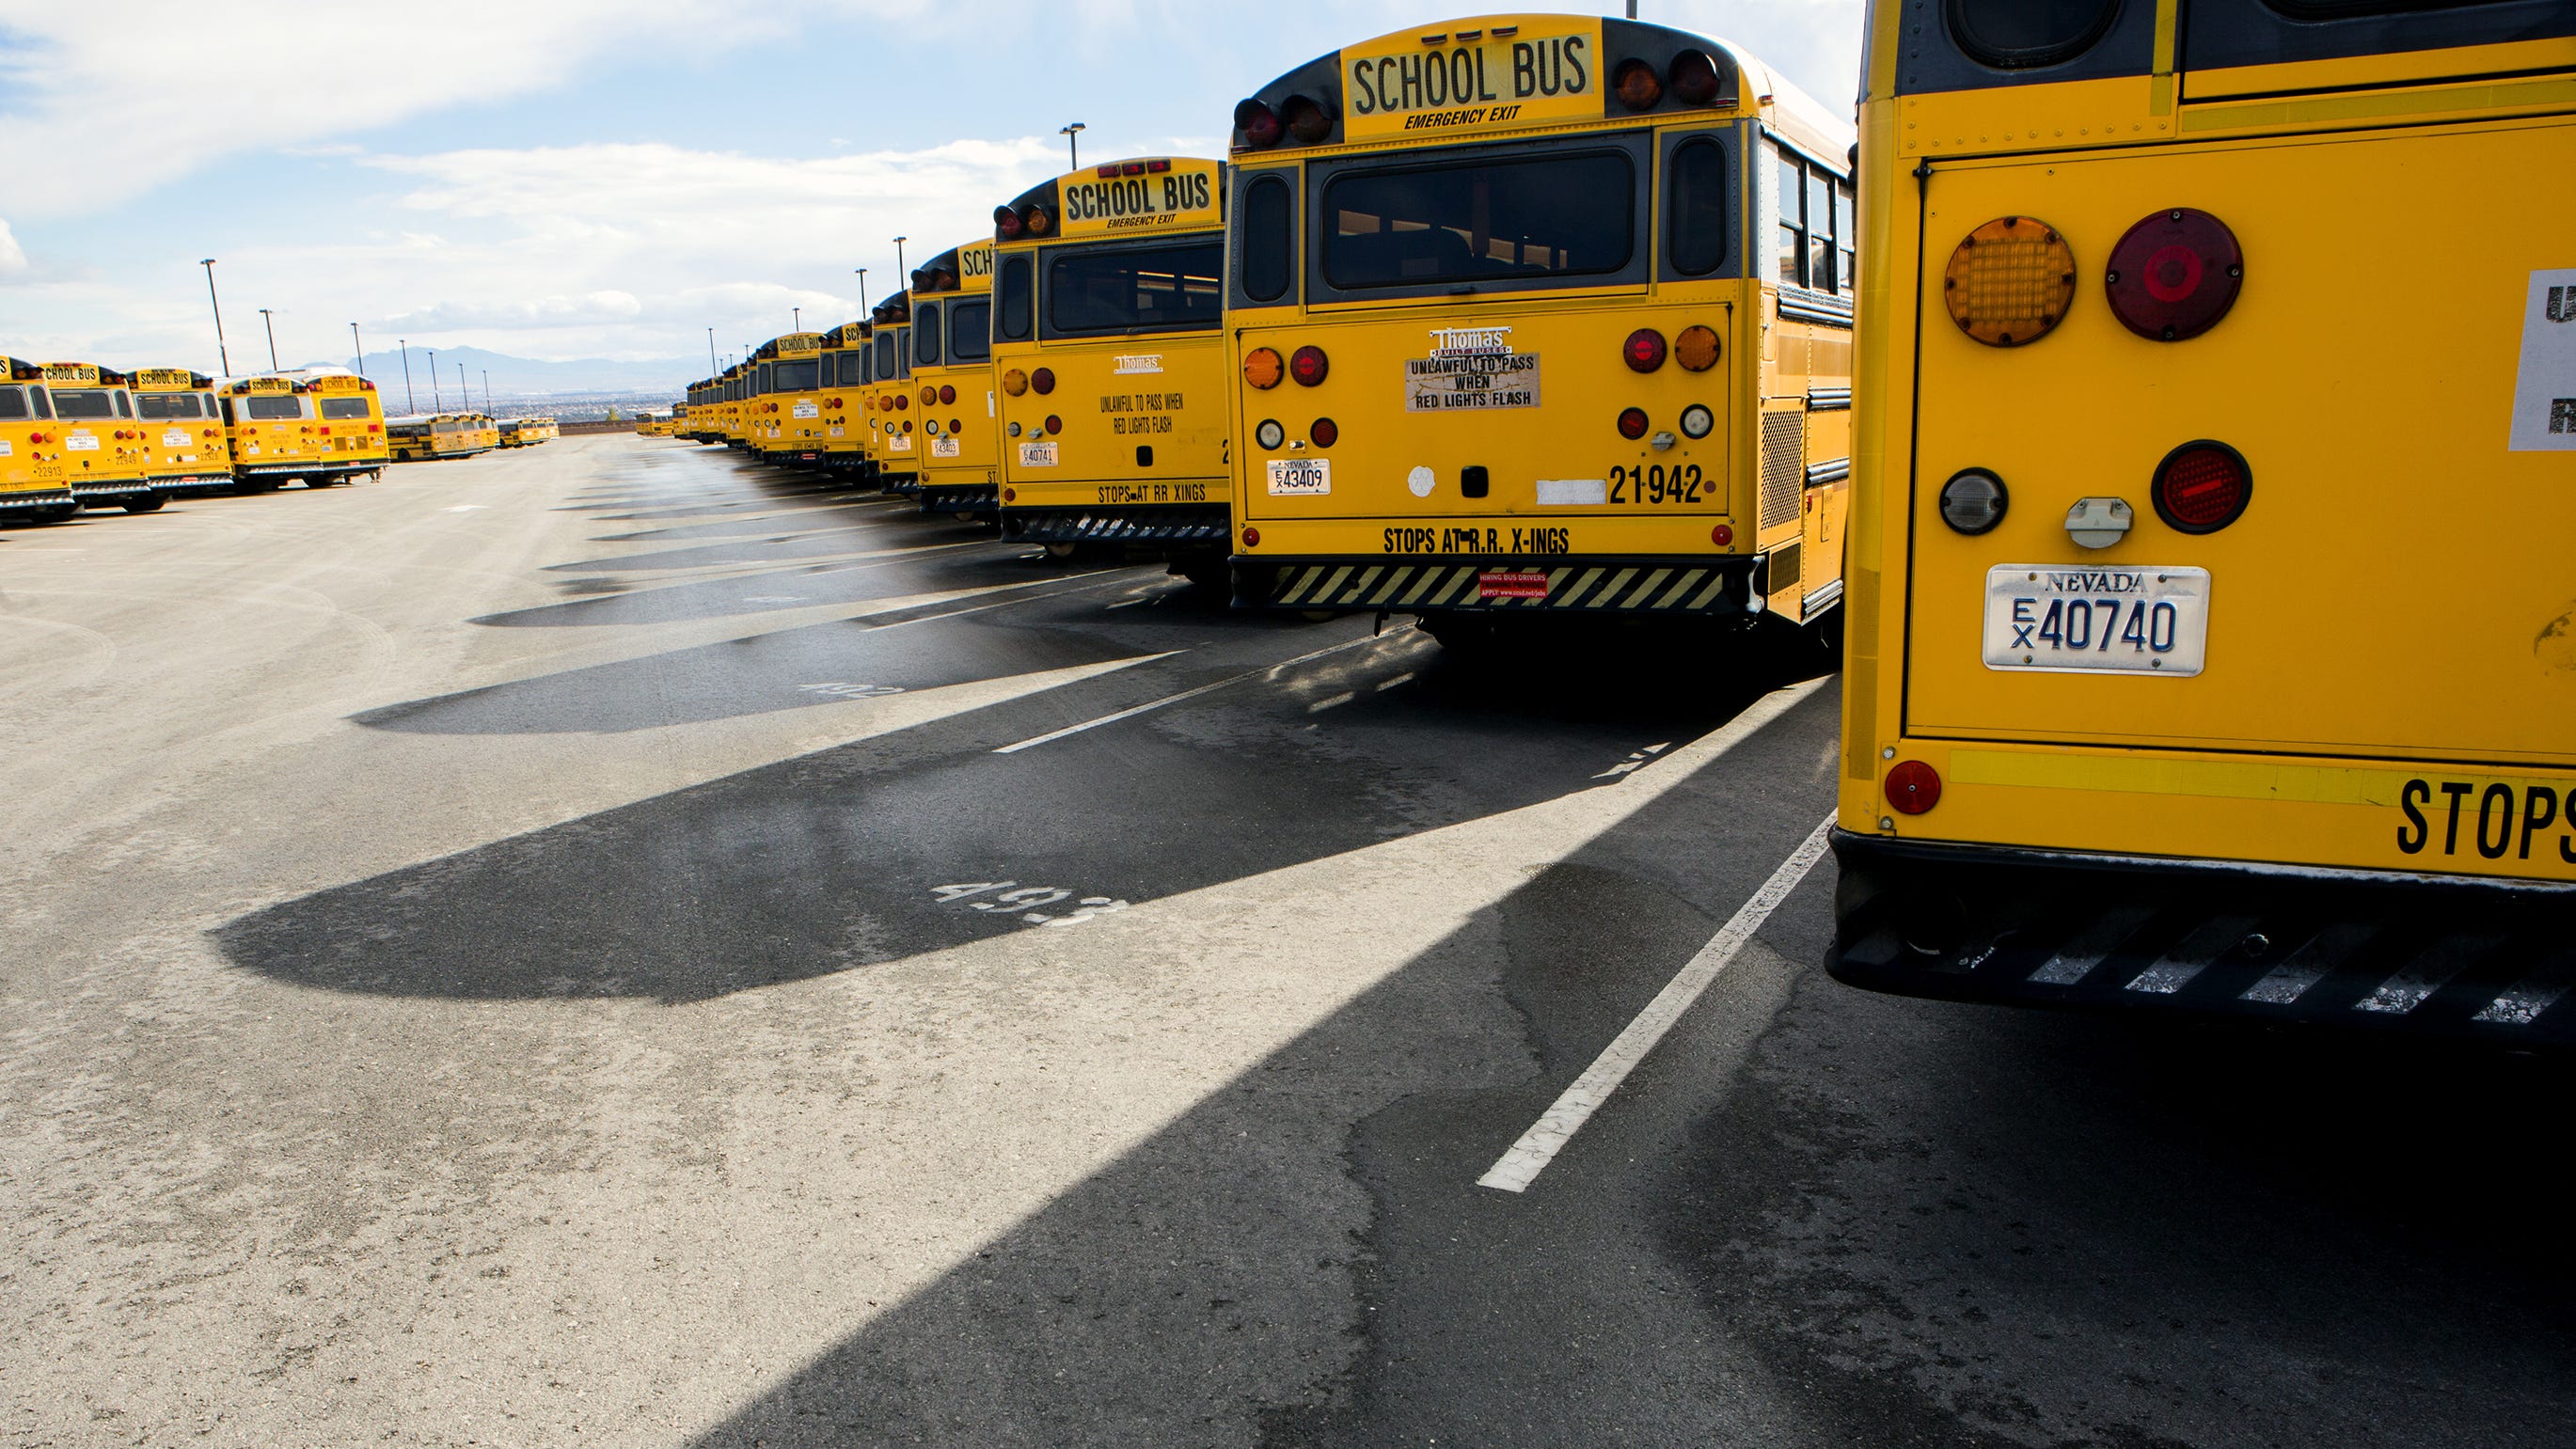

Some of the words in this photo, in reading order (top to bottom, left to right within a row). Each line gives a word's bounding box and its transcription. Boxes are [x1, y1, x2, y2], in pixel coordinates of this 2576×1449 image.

[1354, 47, 1496, 115] SCHOOL
[1512, 36, 1586, 99] BUS
[1404, 108, 1487, 130] EMERGENCY
[1489, 104, 1522, 122] EXIT
[1067, 179, 1155, 220] SCHOOL
[1163, 173, 1209, 211] BUS
[1107, 215, 1157, 228] EMERGENCY
[1157, 213, 1177, 225] EXIT
[964, 249, 992, 276] SCH
[780, 339, 808, 352] SCHOOL
[810, 337, 819, 349] BU
[1435, 326, 1506, 350] Thomas
[1117, 354, 1159, 369] Thomas
[1412, 358, 1475, 374] UNLAWFUL
[1480, 357, 1495, 371] TO
[1502, 356, 1534, 370] PASS
[45, 368, 75, 380] CHOOL
[78, 368, 96, 380] BUS
[141, 373, 171, 385] SCHOOL
[173, 372, 189, 384] BUS
[1455, 375, 1490, 390] WHEN
[252, 381, 276, 390] SCHOOL
[277, 380, 289, 389] BUS
[1100, 395, 1133, 413] UNLAWFUL
[1135, 394, 1144, 411] TO
[1146, 393, 1162, 411] PASS
[1164, 393, 1183, 410] WHEN
[1416, 395, 1438, 408] RED
[1445, 393, 1486, 407] LIGHTS
[1493, 391, 1531, 405] FLASH
[1114, 417, 1126, 434] RED
[1129, 417, 1150, 434] LIGHTS
[1152, 416, 1173, 433] FLASH
[1029, 449, 1052, 462] 40741
[38, 465, 62, 478] 22913
[1284, 469, 1322, 487] 43409
[1098, 485, 1130, 503] STOPS
[1136, 485, 1148, 502] AT
[1154, 484, 1168, 501] RR
[1174, 483, 1206, 501] XINGS
[1609, 464, 1702, 504] 21942
[1383, 528, 1435, 553] STOPS
[1442, 528, 1462, 553] AT
[1469, 528, 1504, 553] R.R.
[1511, 528, 1569, 553] X-INGS
[2045, 572, 2149, 594] NEVADA
[2037, 598, 2179, 653] 40740
[929, 880, 1130, 927] 493
